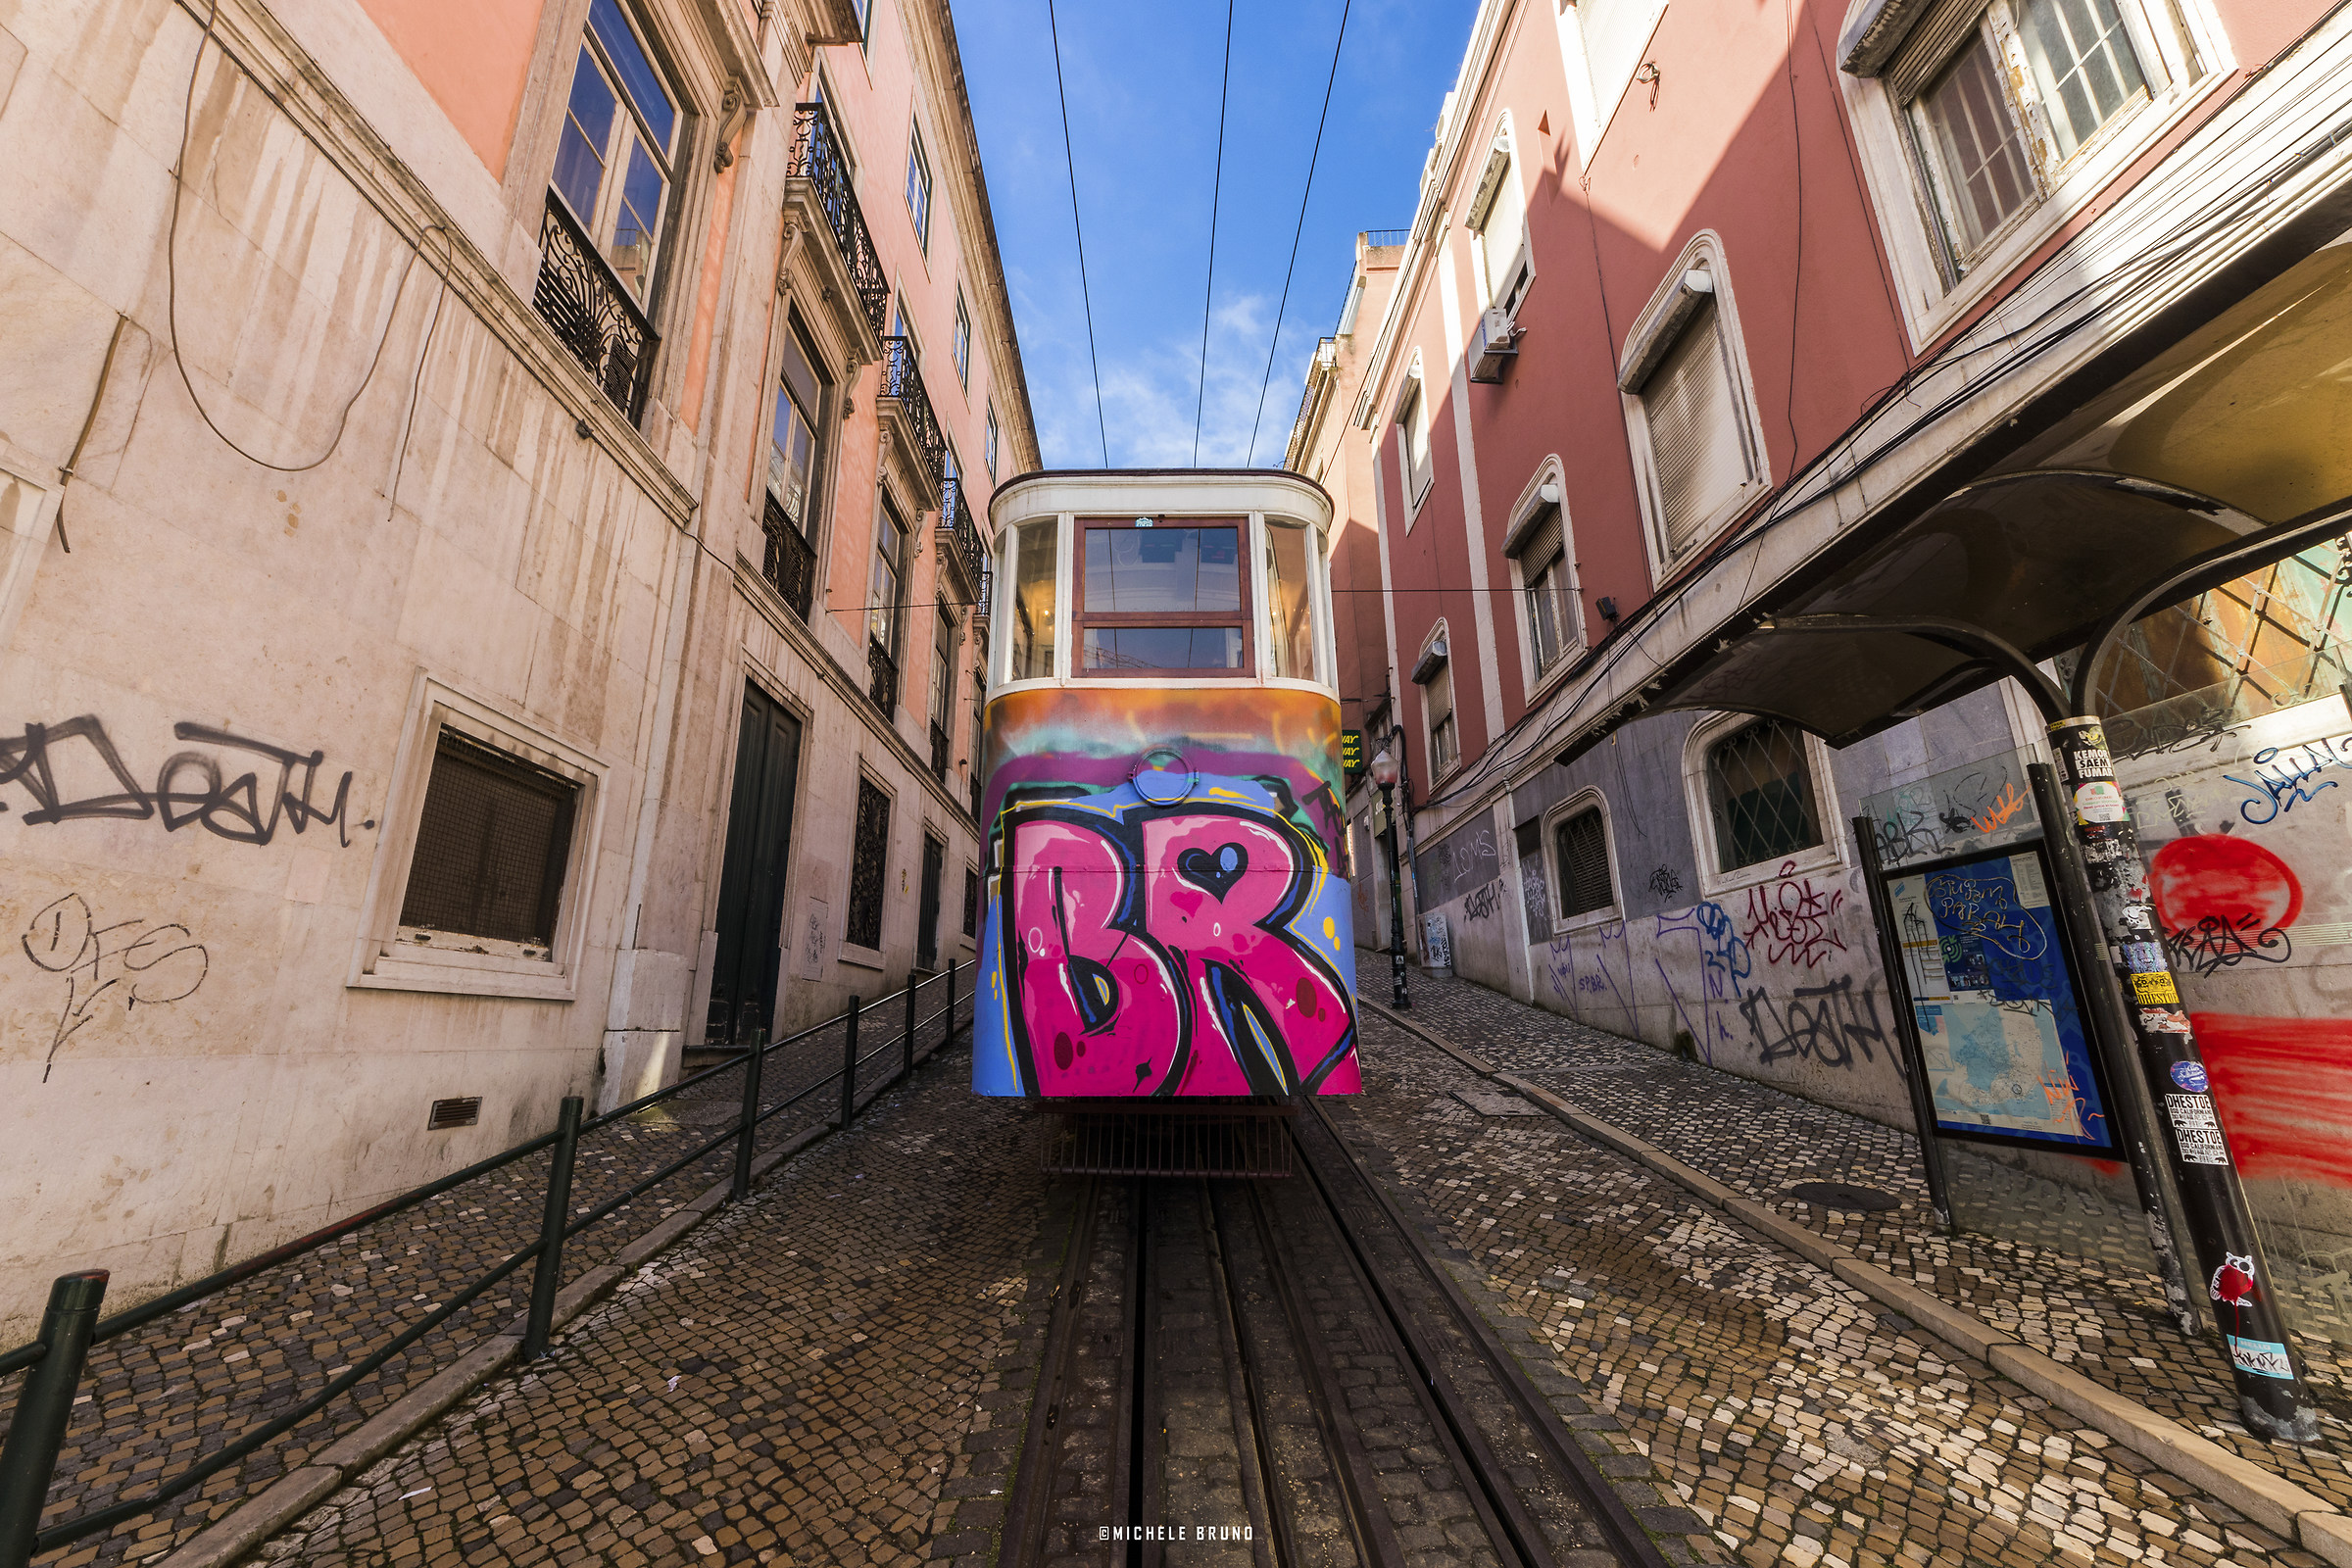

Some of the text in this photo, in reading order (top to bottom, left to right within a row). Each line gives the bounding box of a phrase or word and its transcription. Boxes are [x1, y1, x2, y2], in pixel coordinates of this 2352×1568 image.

[2079, 767, 2114, 779] FUMAR
[2166, 1094, 2211, 1109] DHESTOE
[2176, 1128, 2223, 1145] DHESTOE
[2240, 1340, 2271, 1350] HELLO
